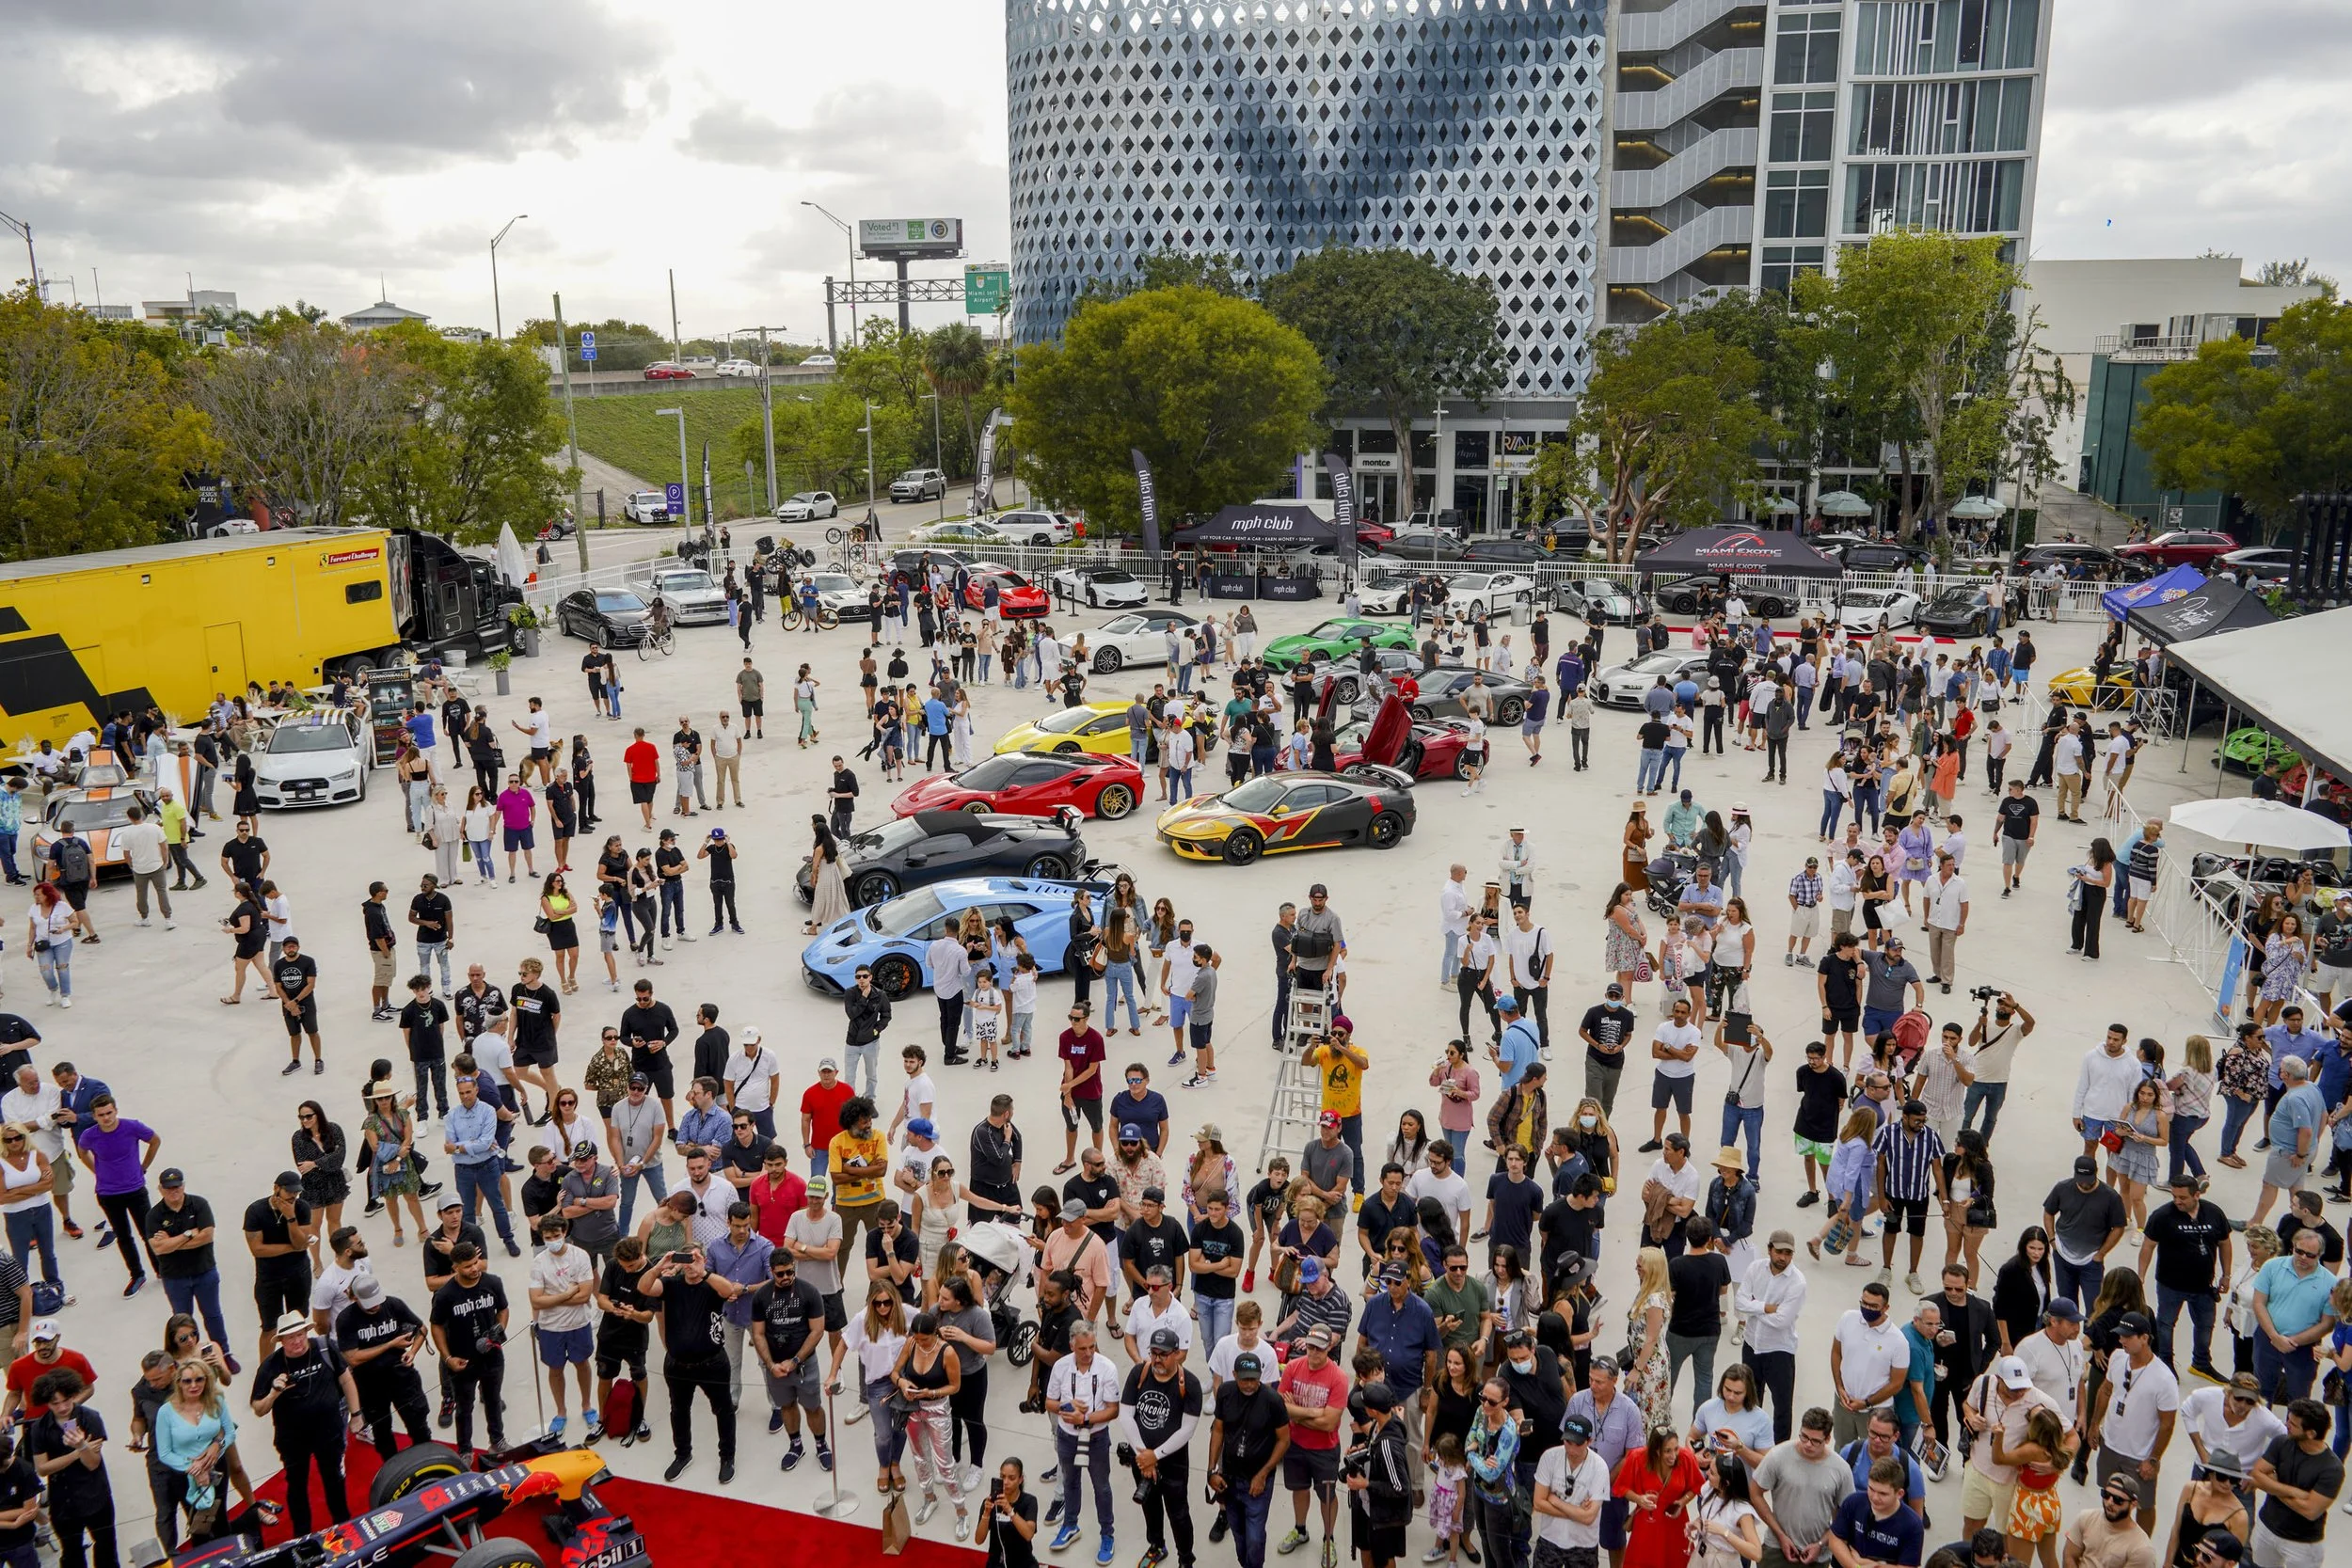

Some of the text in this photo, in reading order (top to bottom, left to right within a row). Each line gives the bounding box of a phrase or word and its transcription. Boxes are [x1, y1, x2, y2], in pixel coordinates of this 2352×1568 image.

[867, 222, 892, 231] Voted
[980, 425, 993, 499] VOSSEN
[1232, 515, 1294, 531] mph club
[352, 551, 377, 560] Challenge
[1221, 584, 1232, 594] mph
[1274, 585, 1296, 594] mph club
[453, 1293, 495, 1317] mph club
[358, 1319, 397, 1341] mph club
[1144, 1393, 1167, 1404] MIAMI
[1136, 1402, 1170, 1417] CONCOURS
[359, 1518, 377, 1541] HONDA
[1876, 1531, 1886, 1543] WITH
[1887, 1535, 1899, 1546] CARS
